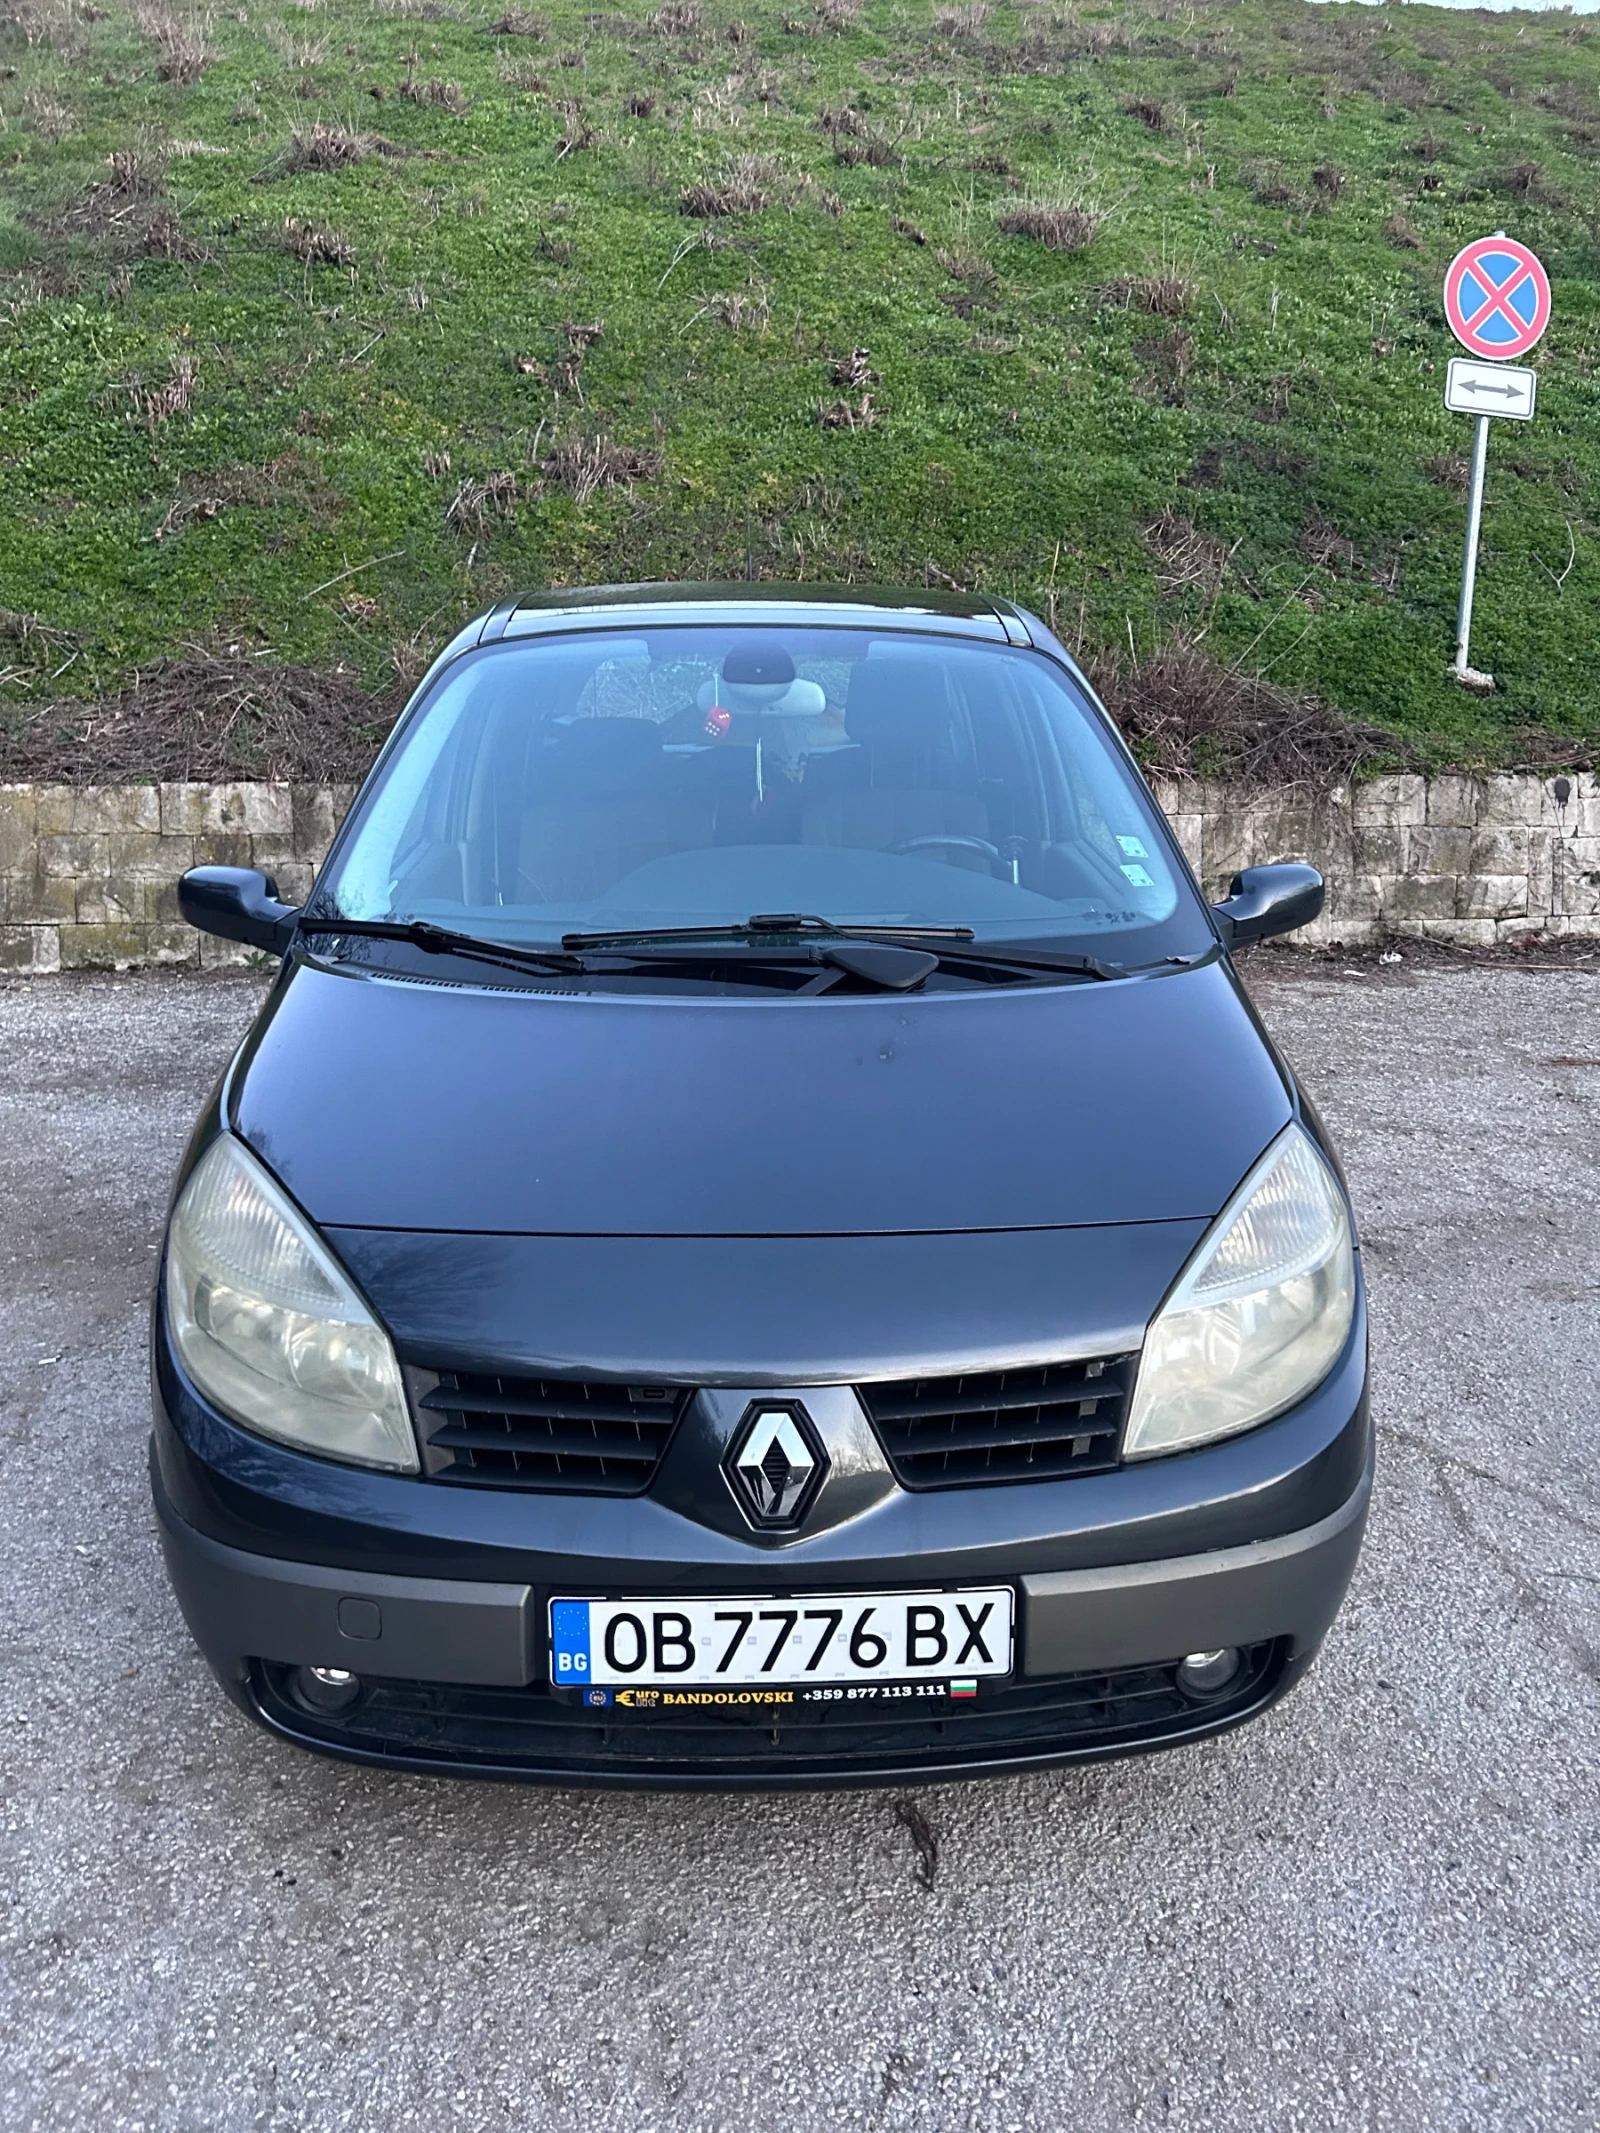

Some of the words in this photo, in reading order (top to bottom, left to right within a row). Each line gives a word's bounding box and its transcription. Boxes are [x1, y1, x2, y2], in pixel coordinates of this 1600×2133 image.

[604, 1612, 696, 1673] OB
[714, 1606, 887, 1672] 7776
[906, 1603, 995, 1667] BX
[559, 1653, 588, 1671] BG
[663, 1692, 794, 1705] BANDOLOVSKI
[802, 1690, 843, 1701] +359
[847, 1688, 878, 1699] 877
[881, 1686, 912, 1697] 113
[916, 1685, 946, 1696] 111
